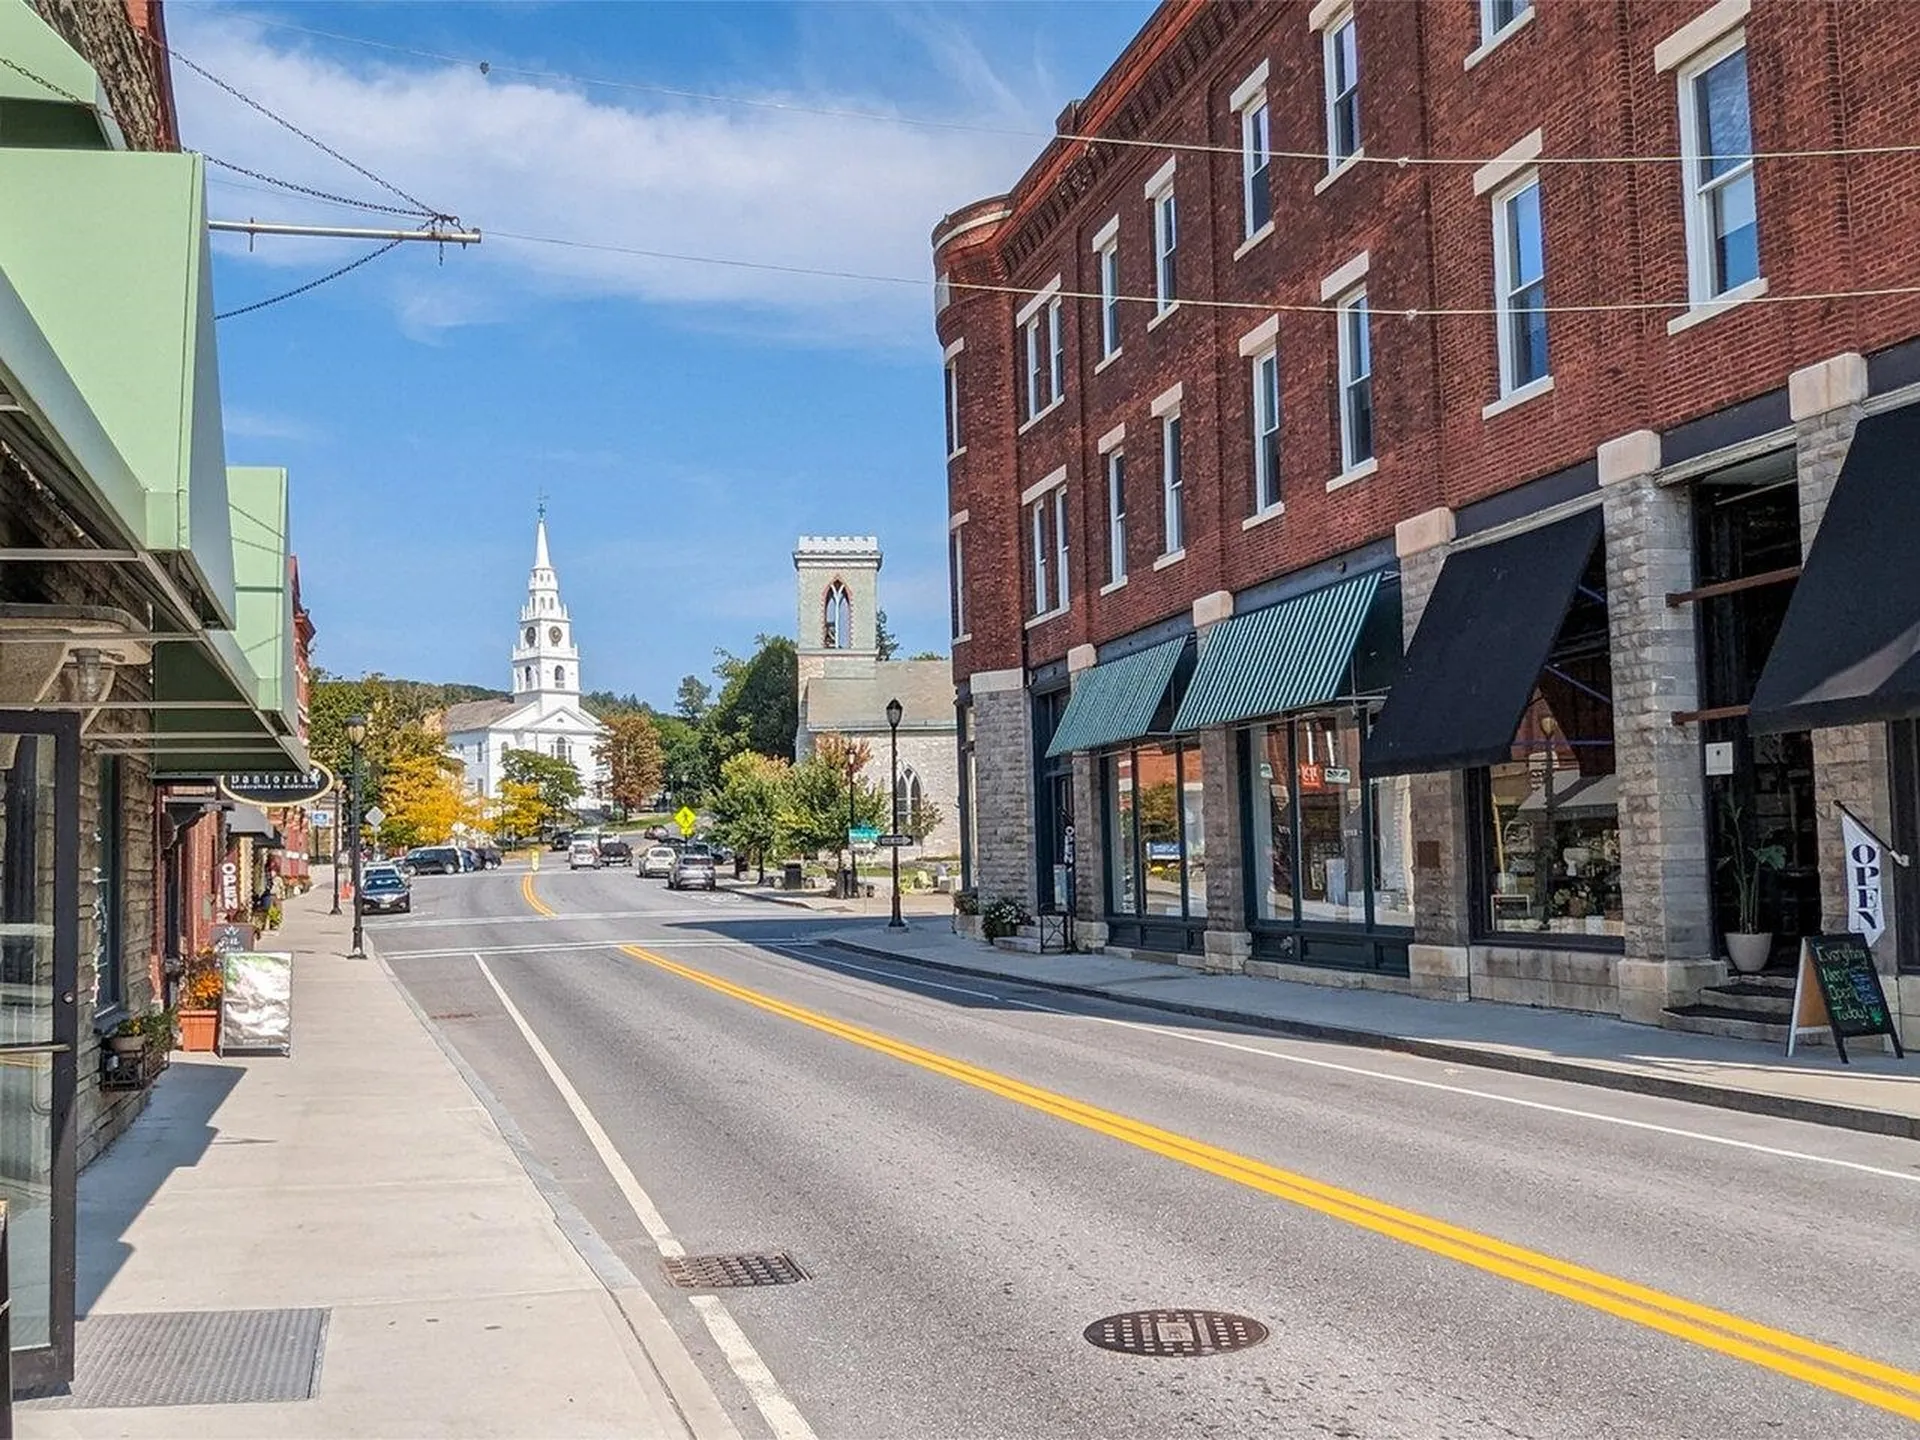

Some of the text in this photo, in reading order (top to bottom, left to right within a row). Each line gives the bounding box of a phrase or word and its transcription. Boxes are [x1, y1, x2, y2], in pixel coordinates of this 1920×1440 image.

[1064, 825, 1075, 864] OPEN
[222, 862, 239, 910] OPEN
[1851, 844, 1879, 929] OPEN
